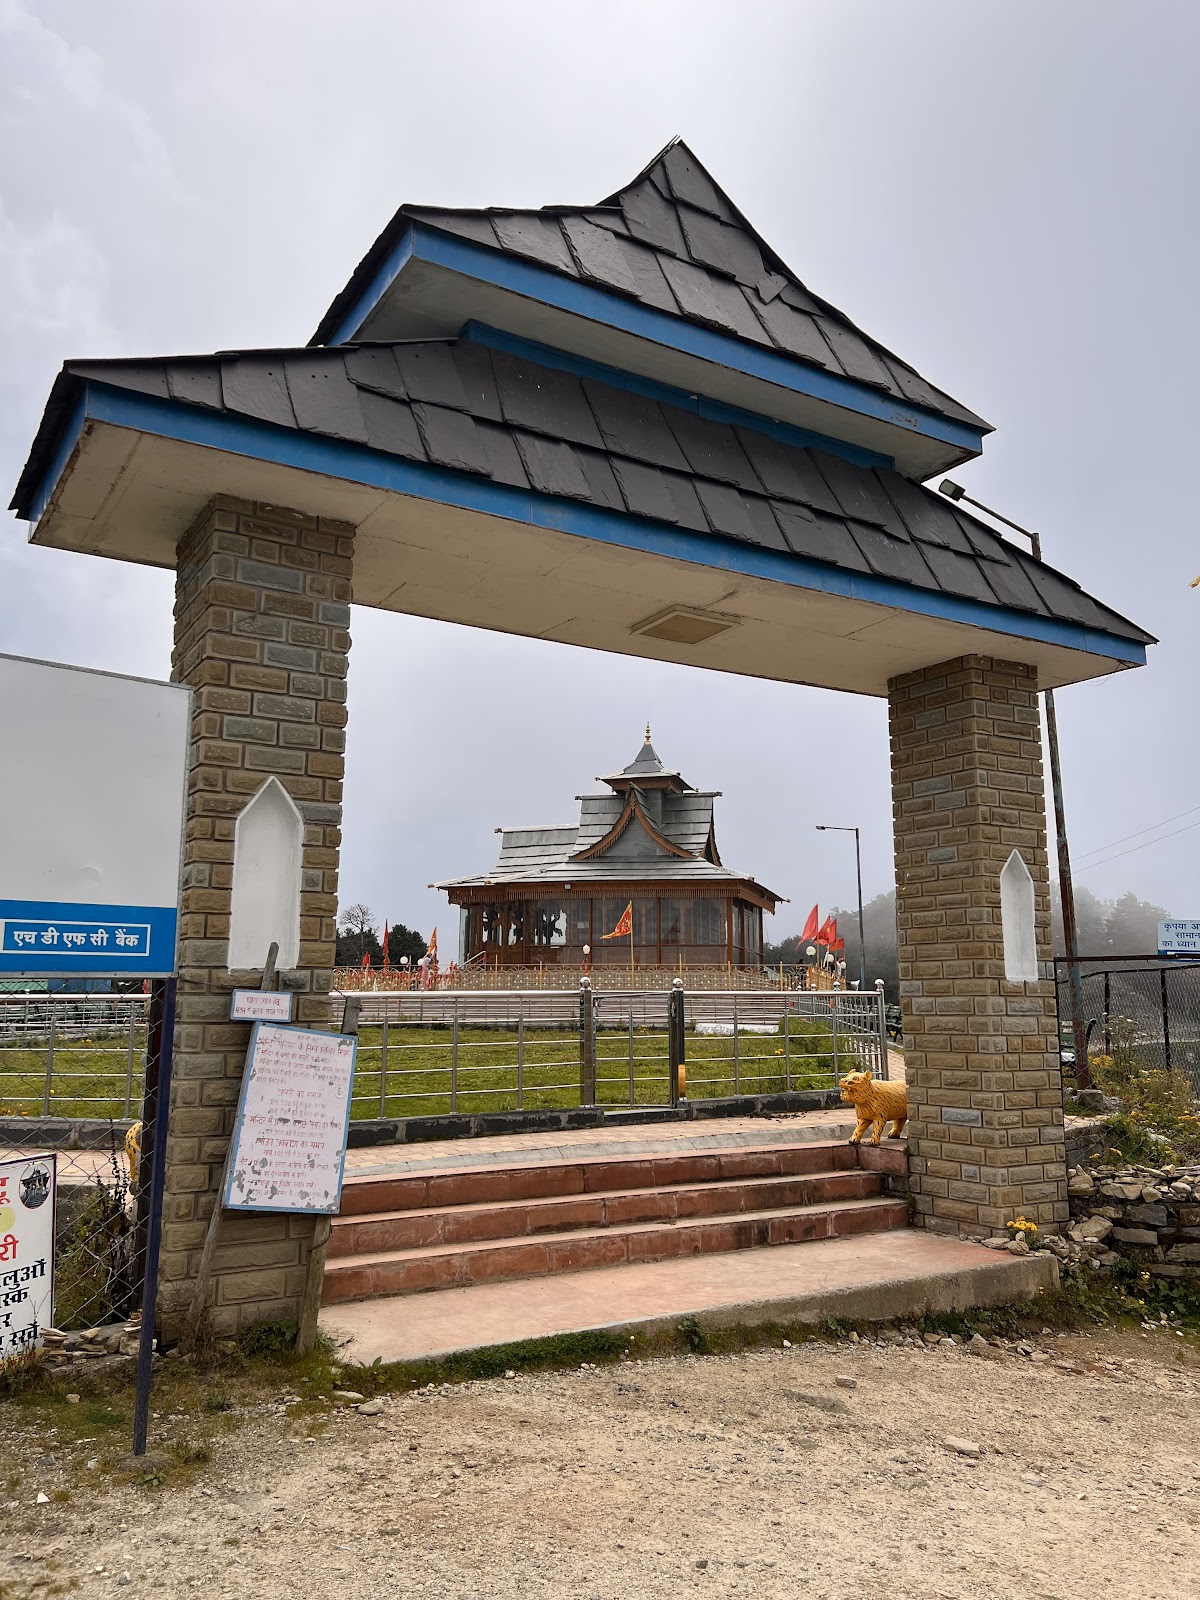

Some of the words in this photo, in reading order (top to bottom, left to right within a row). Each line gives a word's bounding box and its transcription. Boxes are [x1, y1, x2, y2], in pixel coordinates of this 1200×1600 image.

[13, 930, 38, 947] एच
[40, 927, 60, 945] डी
[63, 931, 87, 948] एफ
[90, 928, 109, 946] सी
[115, 928, 139, 947] बैंक
[1163, 922, 1187, 932] कृपया
[1177, 940, 1196, 948] ध्यान
[0, 1258, 47, 1290] लुओं
[0, 1286, 30, 1308] स्क
